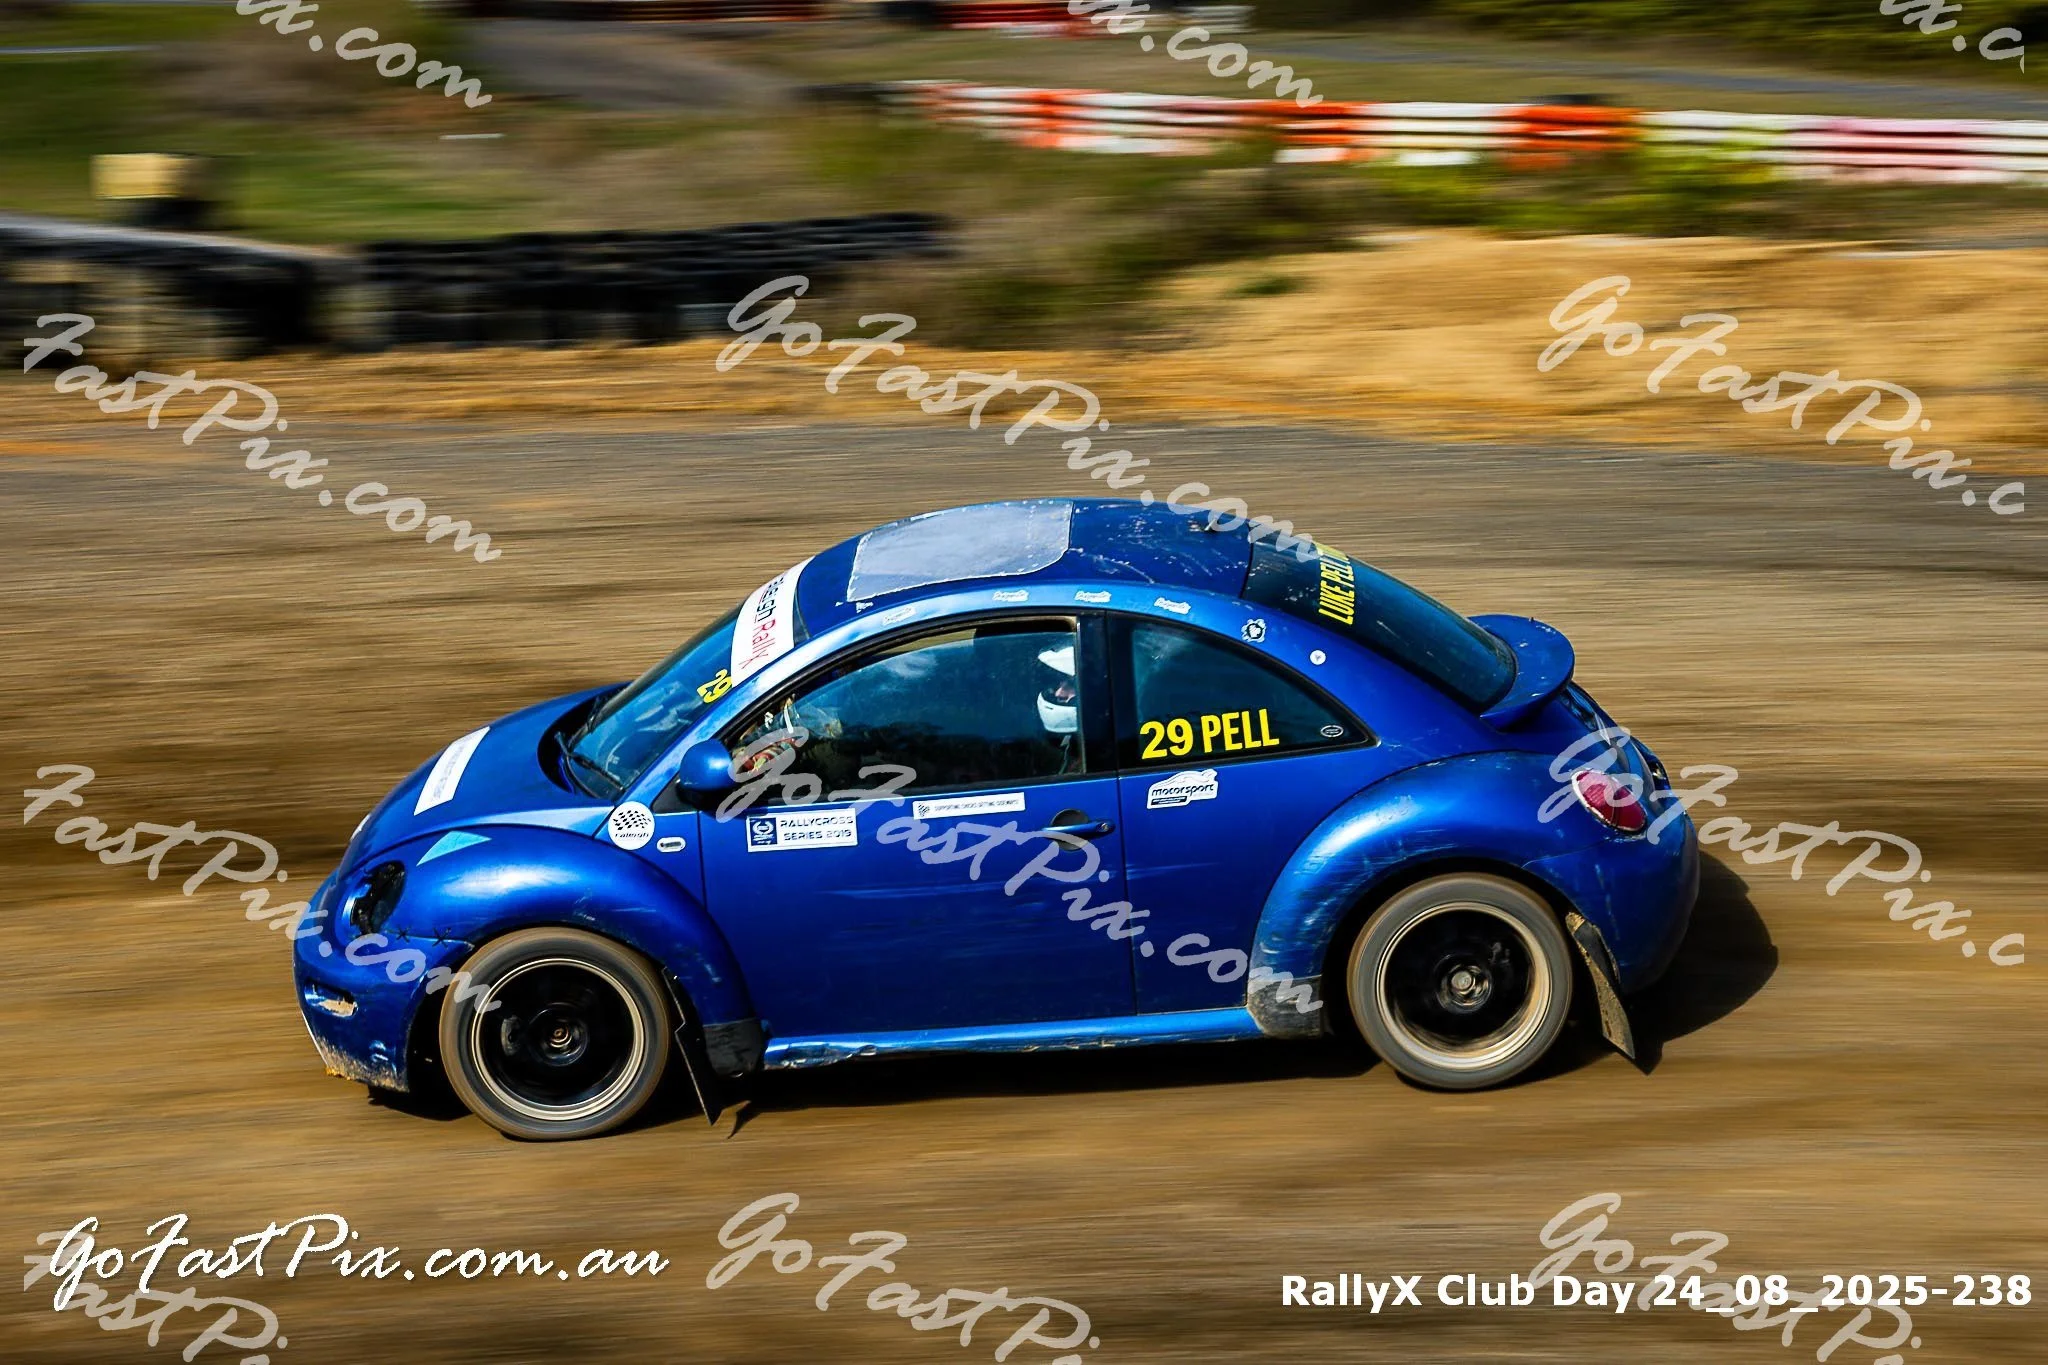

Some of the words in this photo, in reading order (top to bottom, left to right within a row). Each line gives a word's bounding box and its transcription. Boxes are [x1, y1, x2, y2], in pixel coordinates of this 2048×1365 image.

[1318, 580, 1355, 625] LUKE
[696, 668, 733, 704] 29
[1139, 718, 1194, 760] 29
[1200, 708, 1280, 753] PELL
[1151, 783, 1215, 798] motorsport
[780, 815, 854, 828] RALLYCROSS
[783, 830, 823, 841] SERIES
